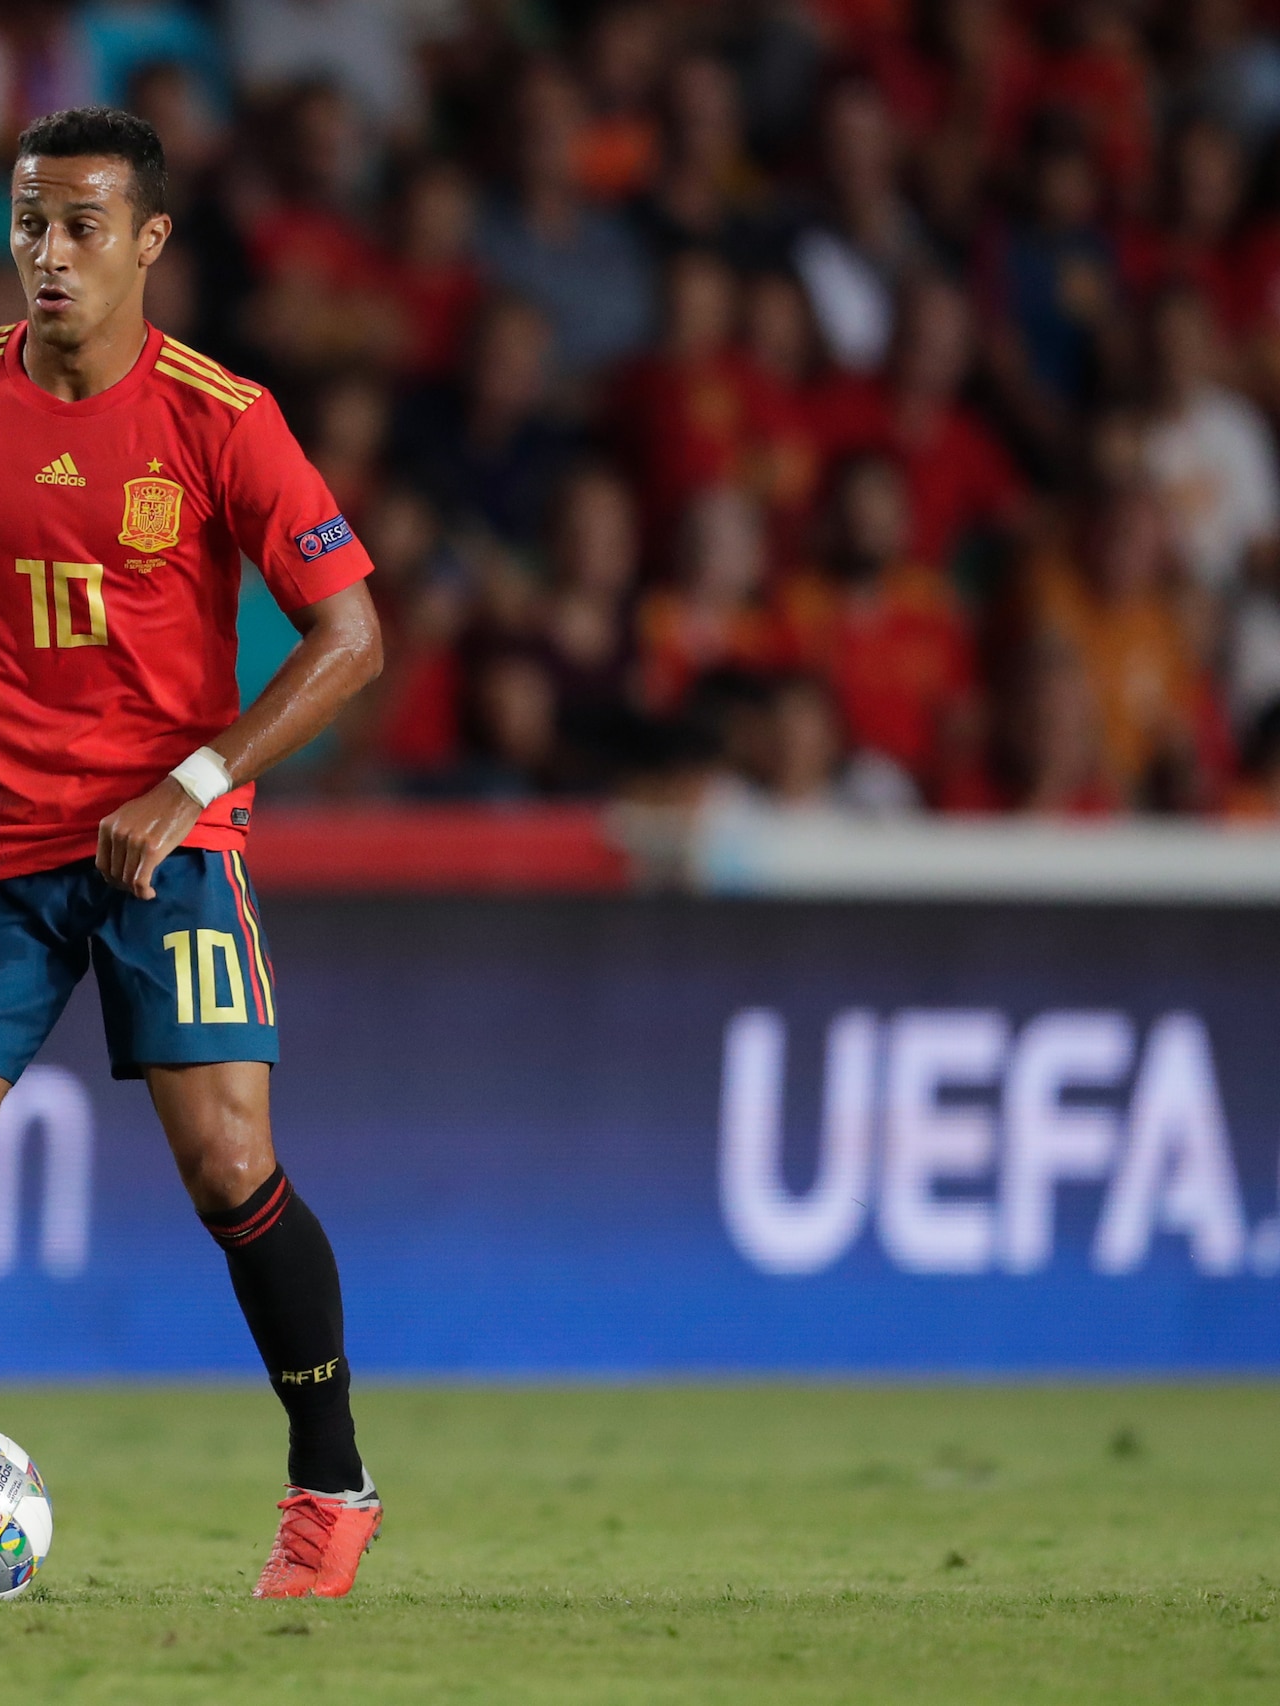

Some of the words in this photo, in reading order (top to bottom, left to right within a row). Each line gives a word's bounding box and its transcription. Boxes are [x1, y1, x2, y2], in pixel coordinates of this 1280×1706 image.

[35, 472, 86, 487] adidas
[15, 558, 109, 648] 10
[162, 928, 249, 1024] 10
